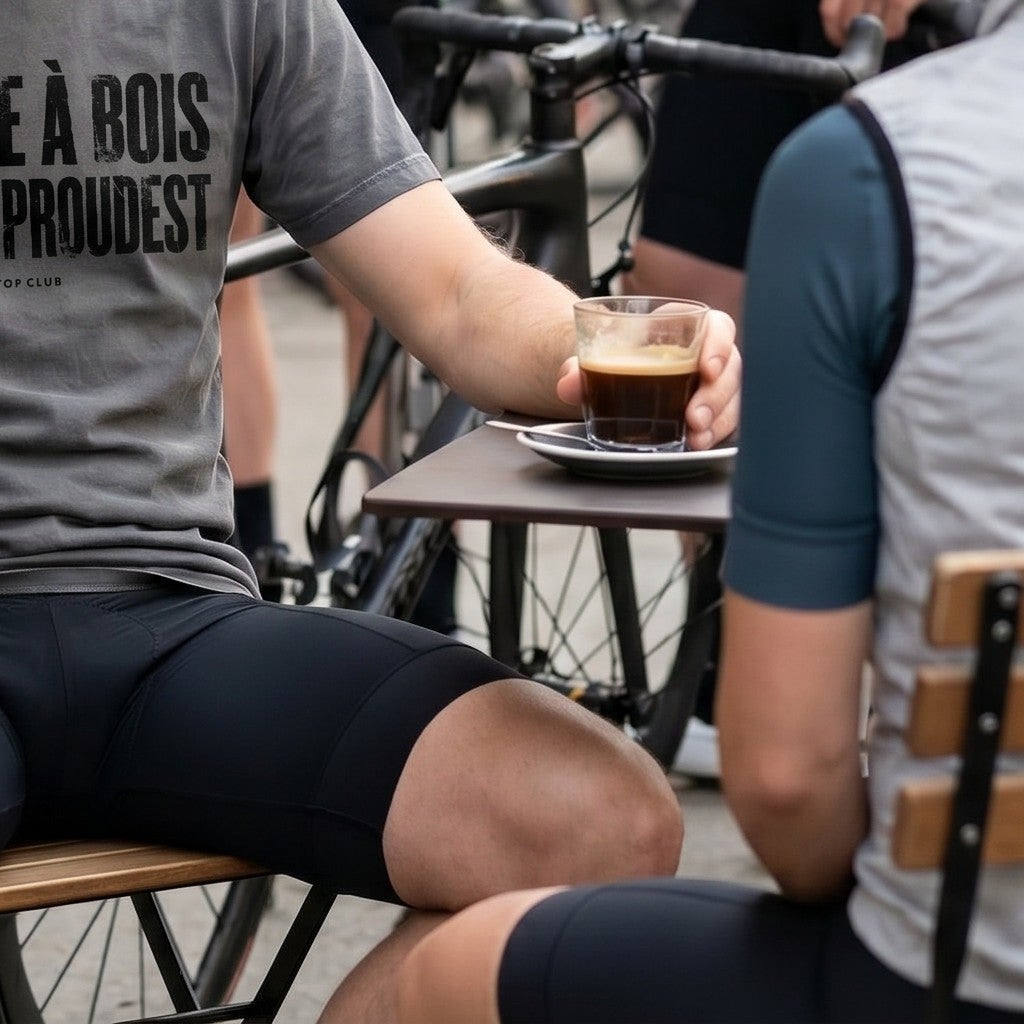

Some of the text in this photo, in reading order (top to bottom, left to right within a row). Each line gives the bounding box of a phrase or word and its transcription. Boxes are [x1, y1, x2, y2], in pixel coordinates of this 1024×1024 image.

[41, 59, 78, 166] À
[91, 71, 211, 164] BOIS
[1, 173, 212, 260] PROUDEST
[26, 276, 62, 288] CLUB
